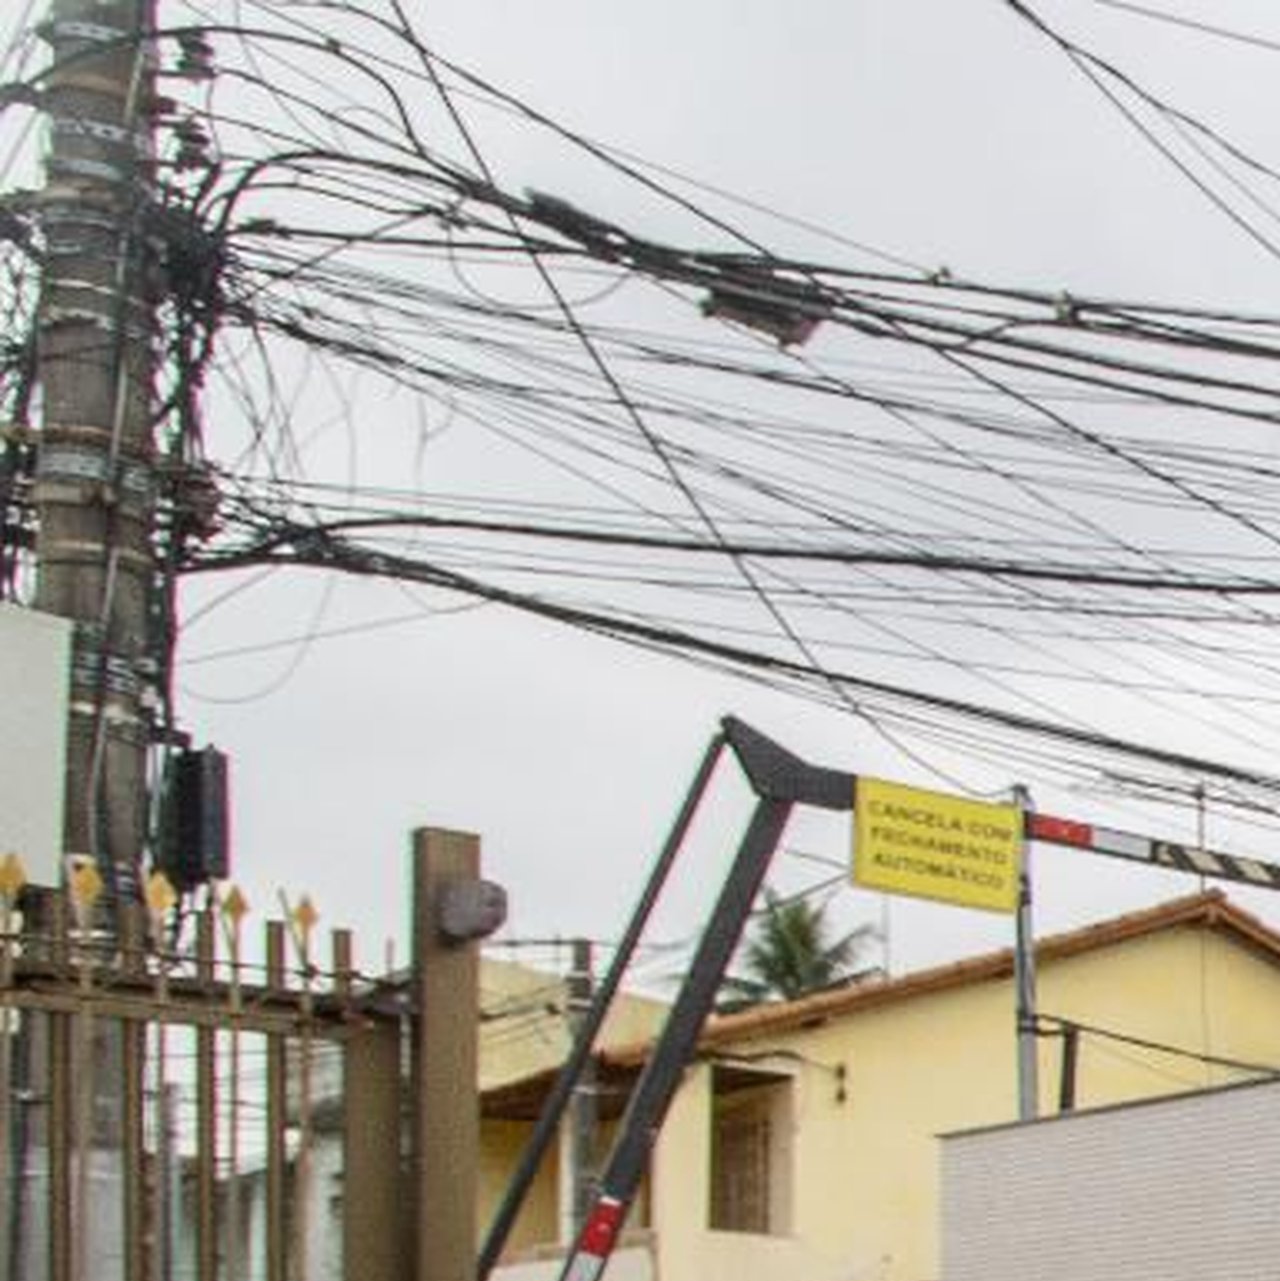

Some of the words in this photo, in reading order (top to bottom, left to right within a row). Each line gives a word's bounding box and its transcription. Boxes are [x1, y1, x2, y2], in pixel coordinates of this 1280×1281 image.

[868, 801, 962, 832] CANCELA
[967, 821, 1013, 841] COM
[870, 826, 1007, 866] FECHAMENTO
